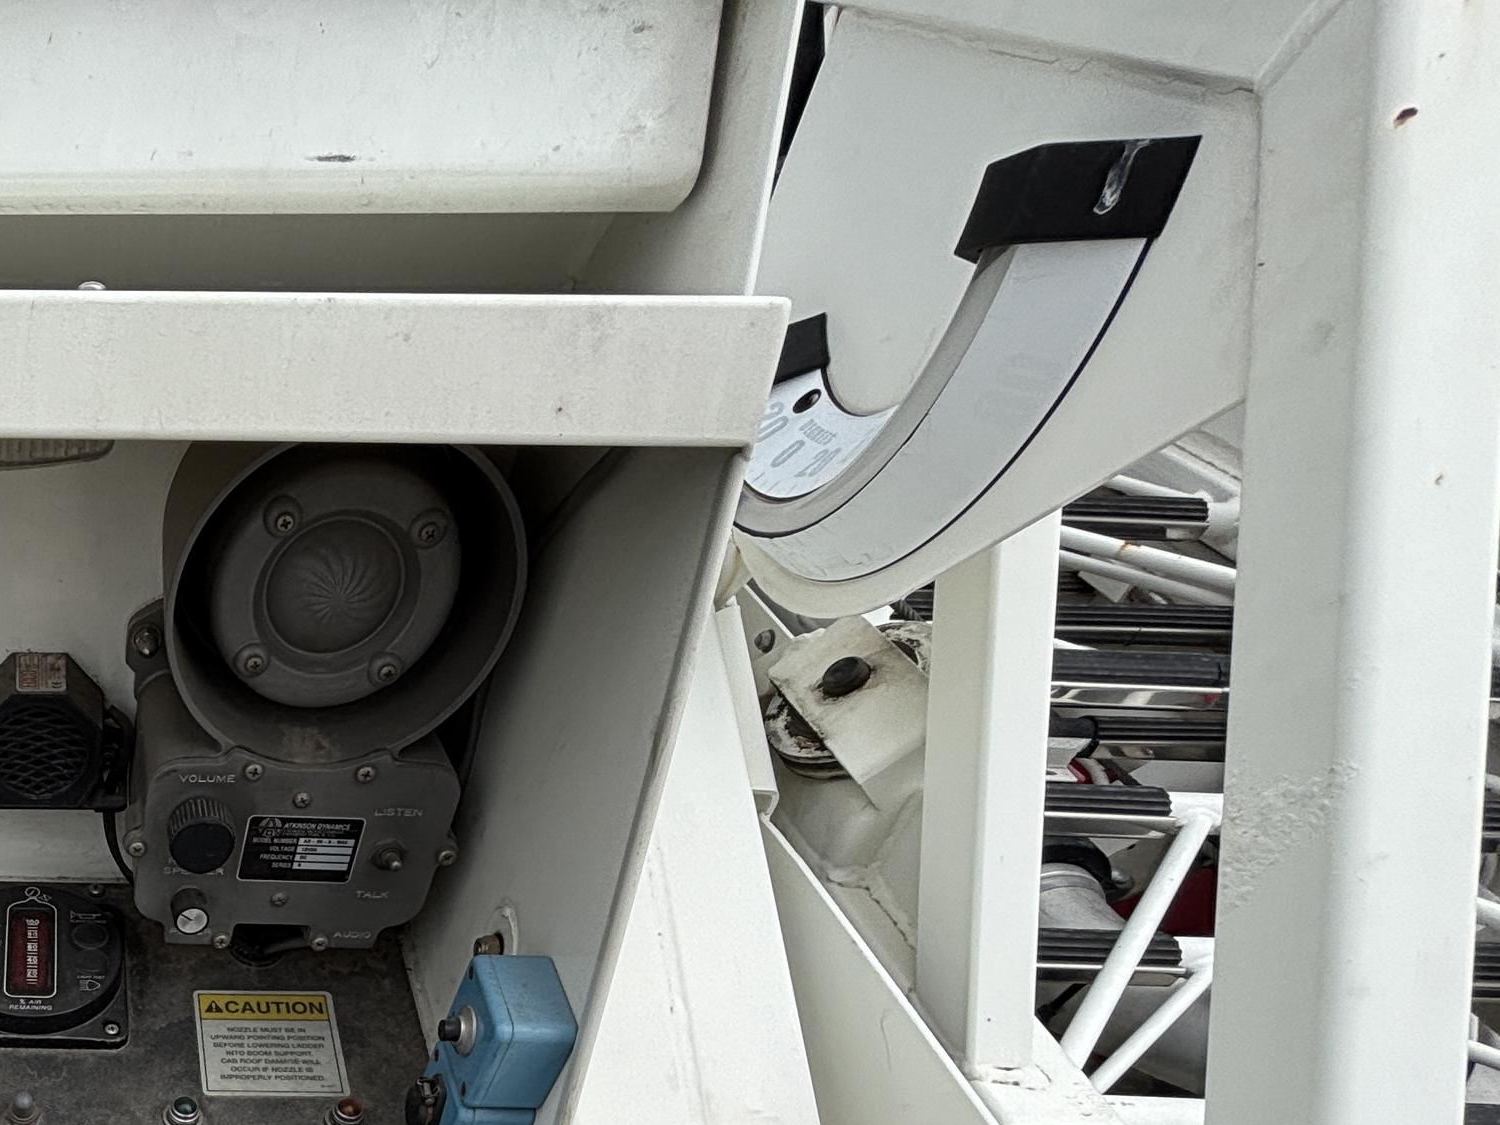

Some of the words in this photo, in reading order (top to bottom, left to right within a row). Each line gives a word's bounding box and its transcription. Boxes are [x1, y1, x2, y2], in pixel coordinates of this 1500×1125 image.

[770, 440, 805, 468] 0
[794, 448, 842, 478] 20
[179, 774, 237, 784] VOLUME
[373, 807, 423, 818] LISTEN
[355, 890, 389, 899] TALK
[332, 930, 372, 939] AUDIO
[225, 1000, 324, 1015] CAUTION
